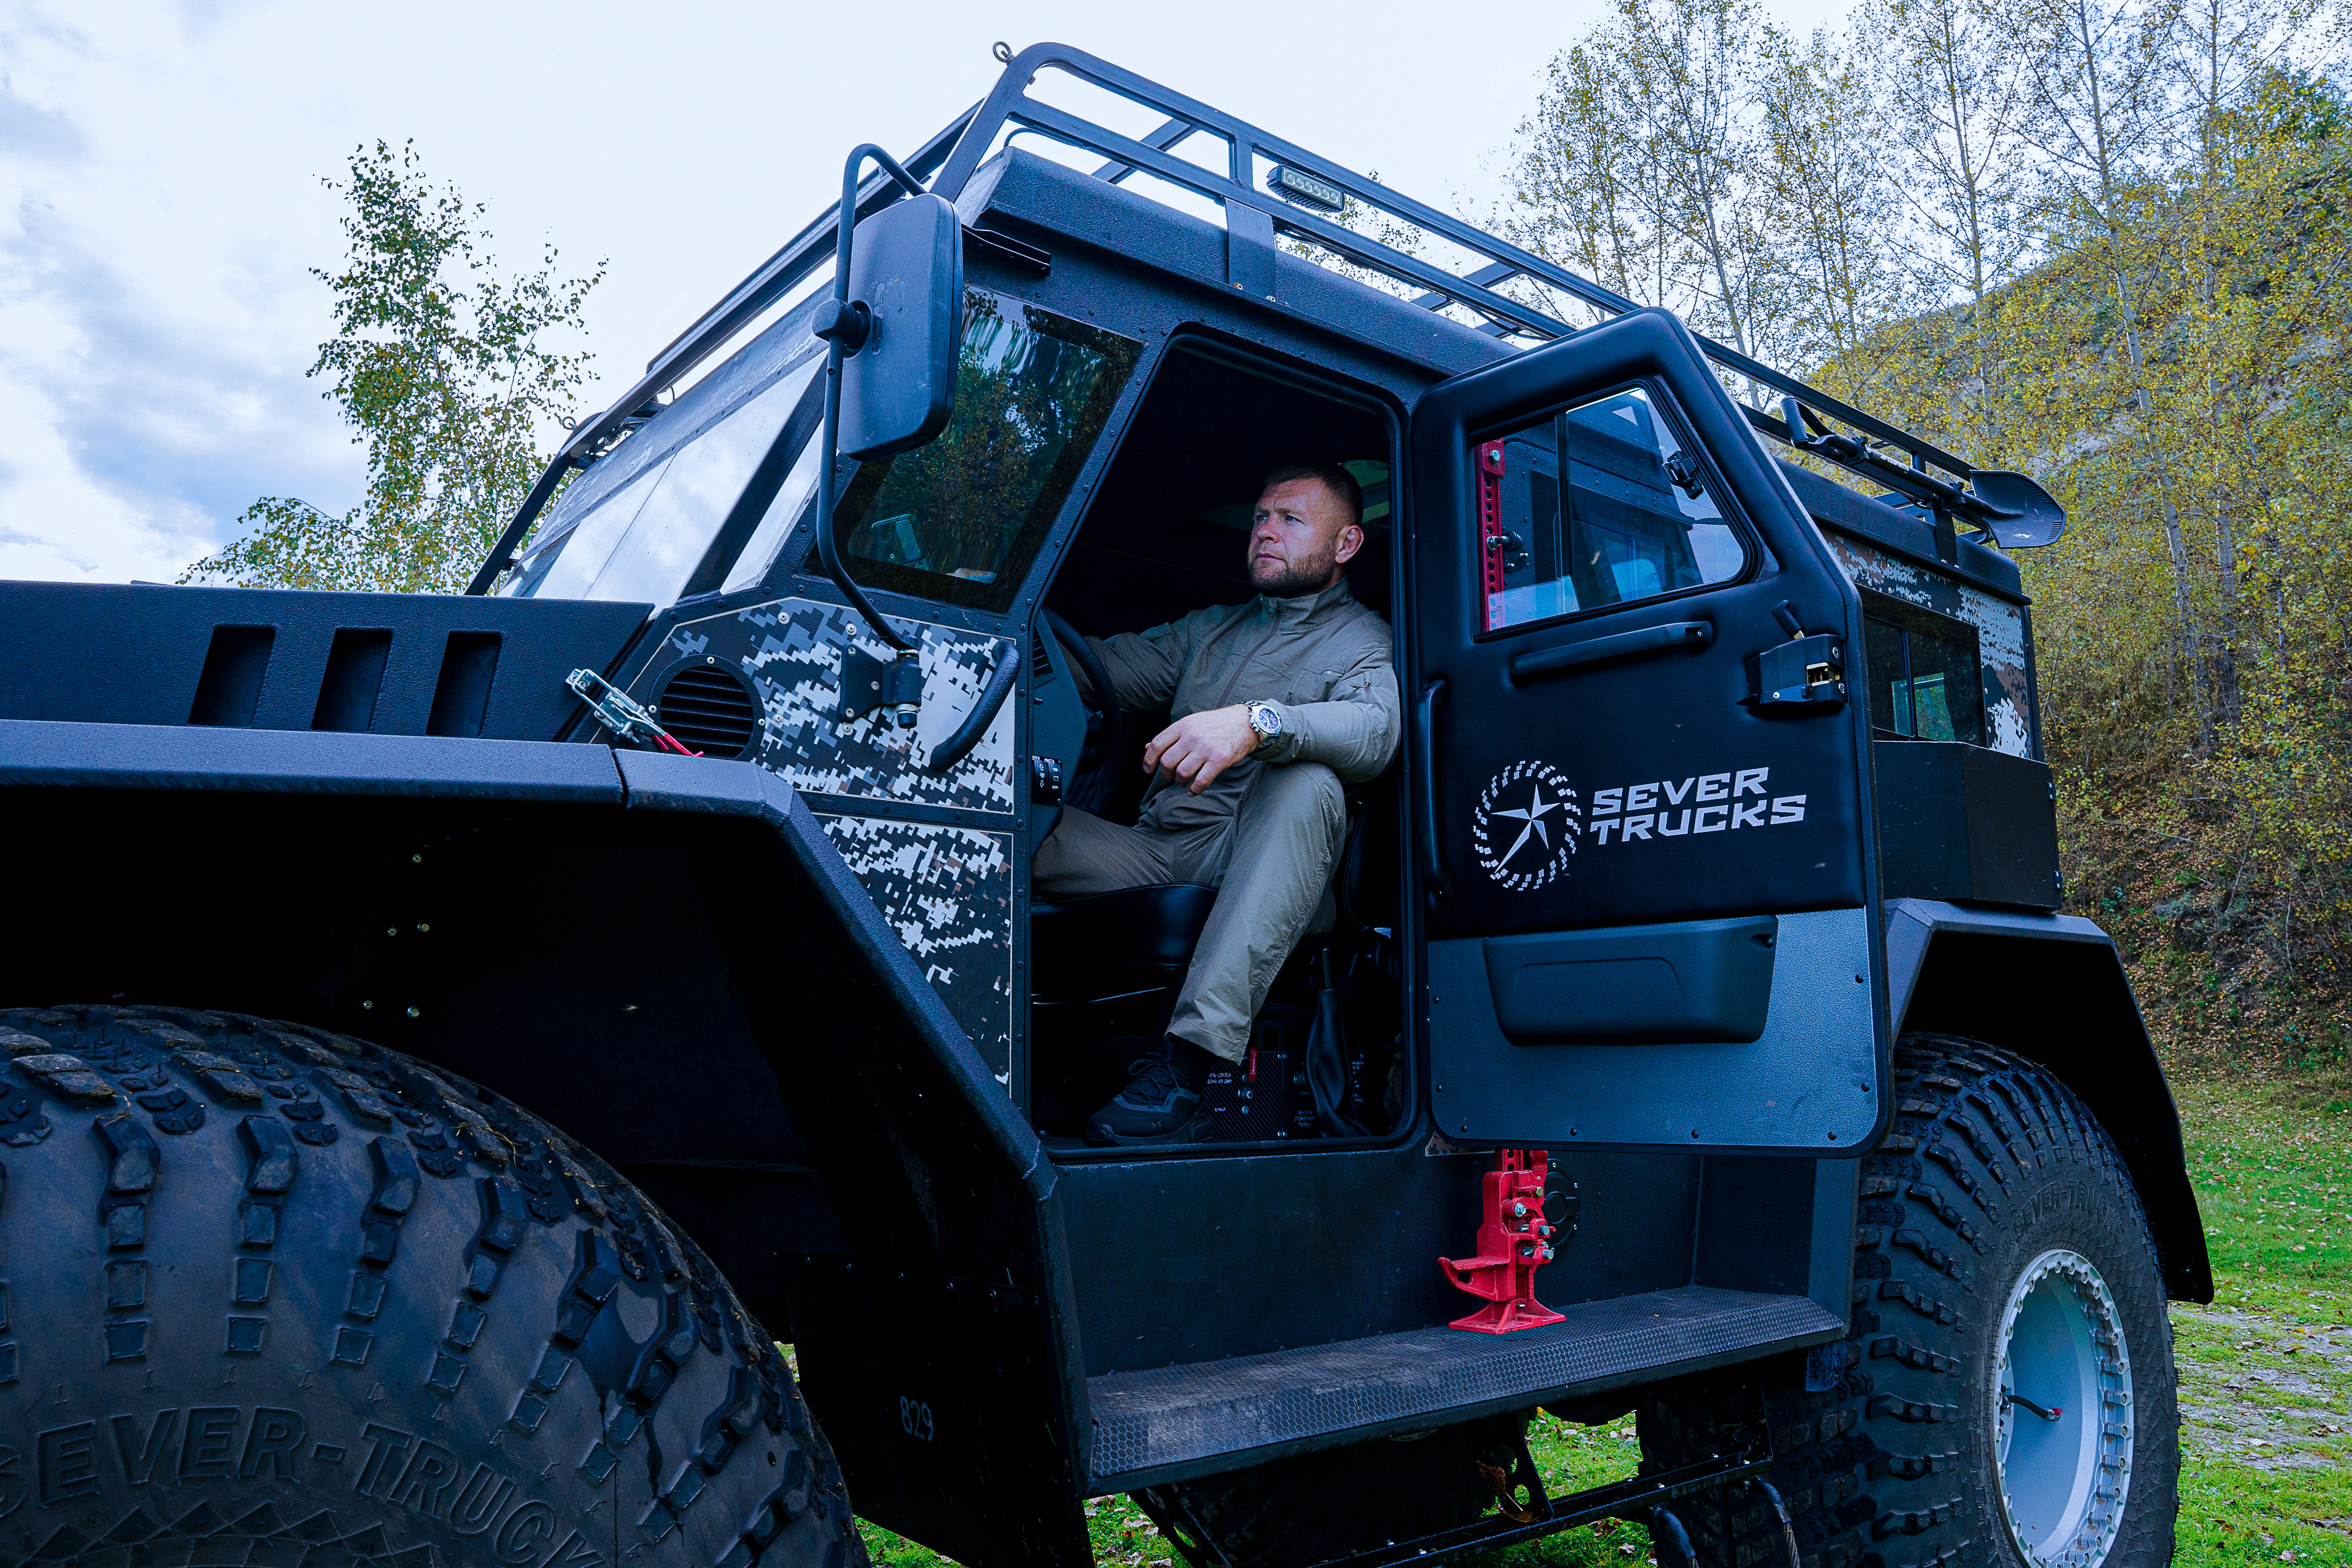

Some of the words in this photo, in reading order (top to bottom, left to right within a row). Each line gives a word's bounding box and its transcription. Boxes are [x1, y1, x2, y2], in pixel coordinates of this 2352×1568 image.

[1592, 767, 1769, 816] SEVER
[1589, 794, 1807, 845] TRUCKS
[2013, 1179, 2127, 1243] SEVER-TRUCKS
[900, 1395, 934, 1442] 829
